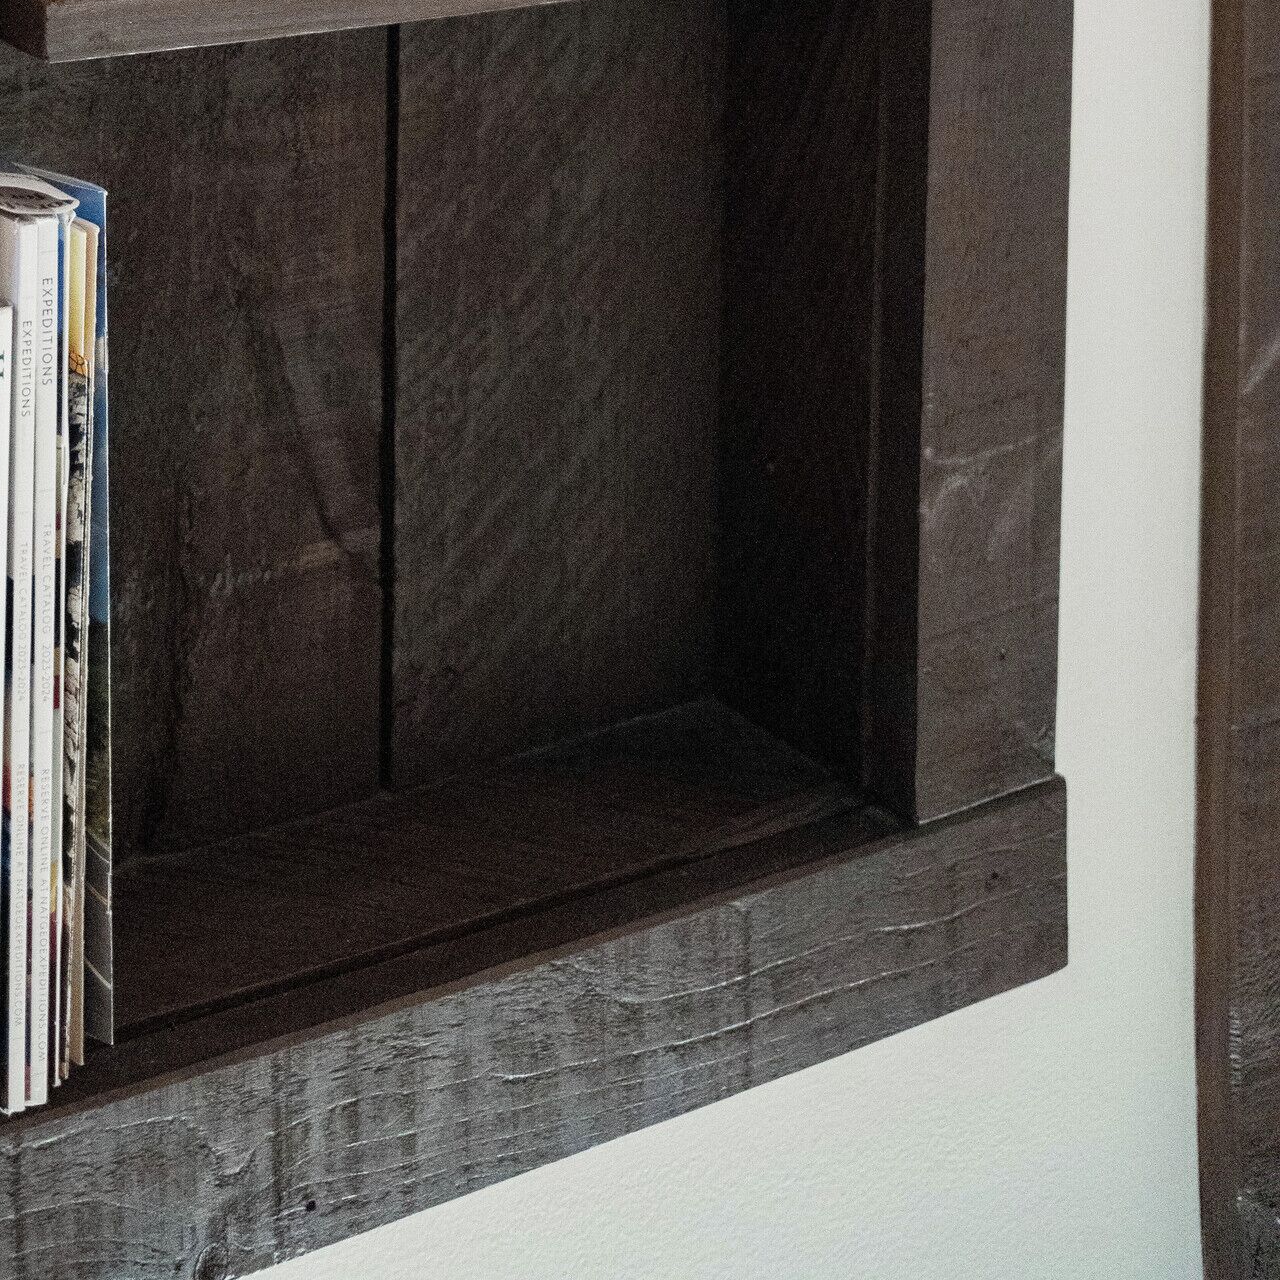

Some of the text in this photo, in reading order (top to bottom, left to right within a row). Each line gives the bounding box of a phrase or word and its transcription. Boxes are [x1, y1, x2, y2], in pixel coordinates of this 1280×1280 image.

[21, 320, 32, 417] EXPEDITIONS
[42, 277, 53, 385] EXPEDITIONS
[43, 523, 51, 568] TRAVEL
[42, 576, 51, 635] CATALOG
